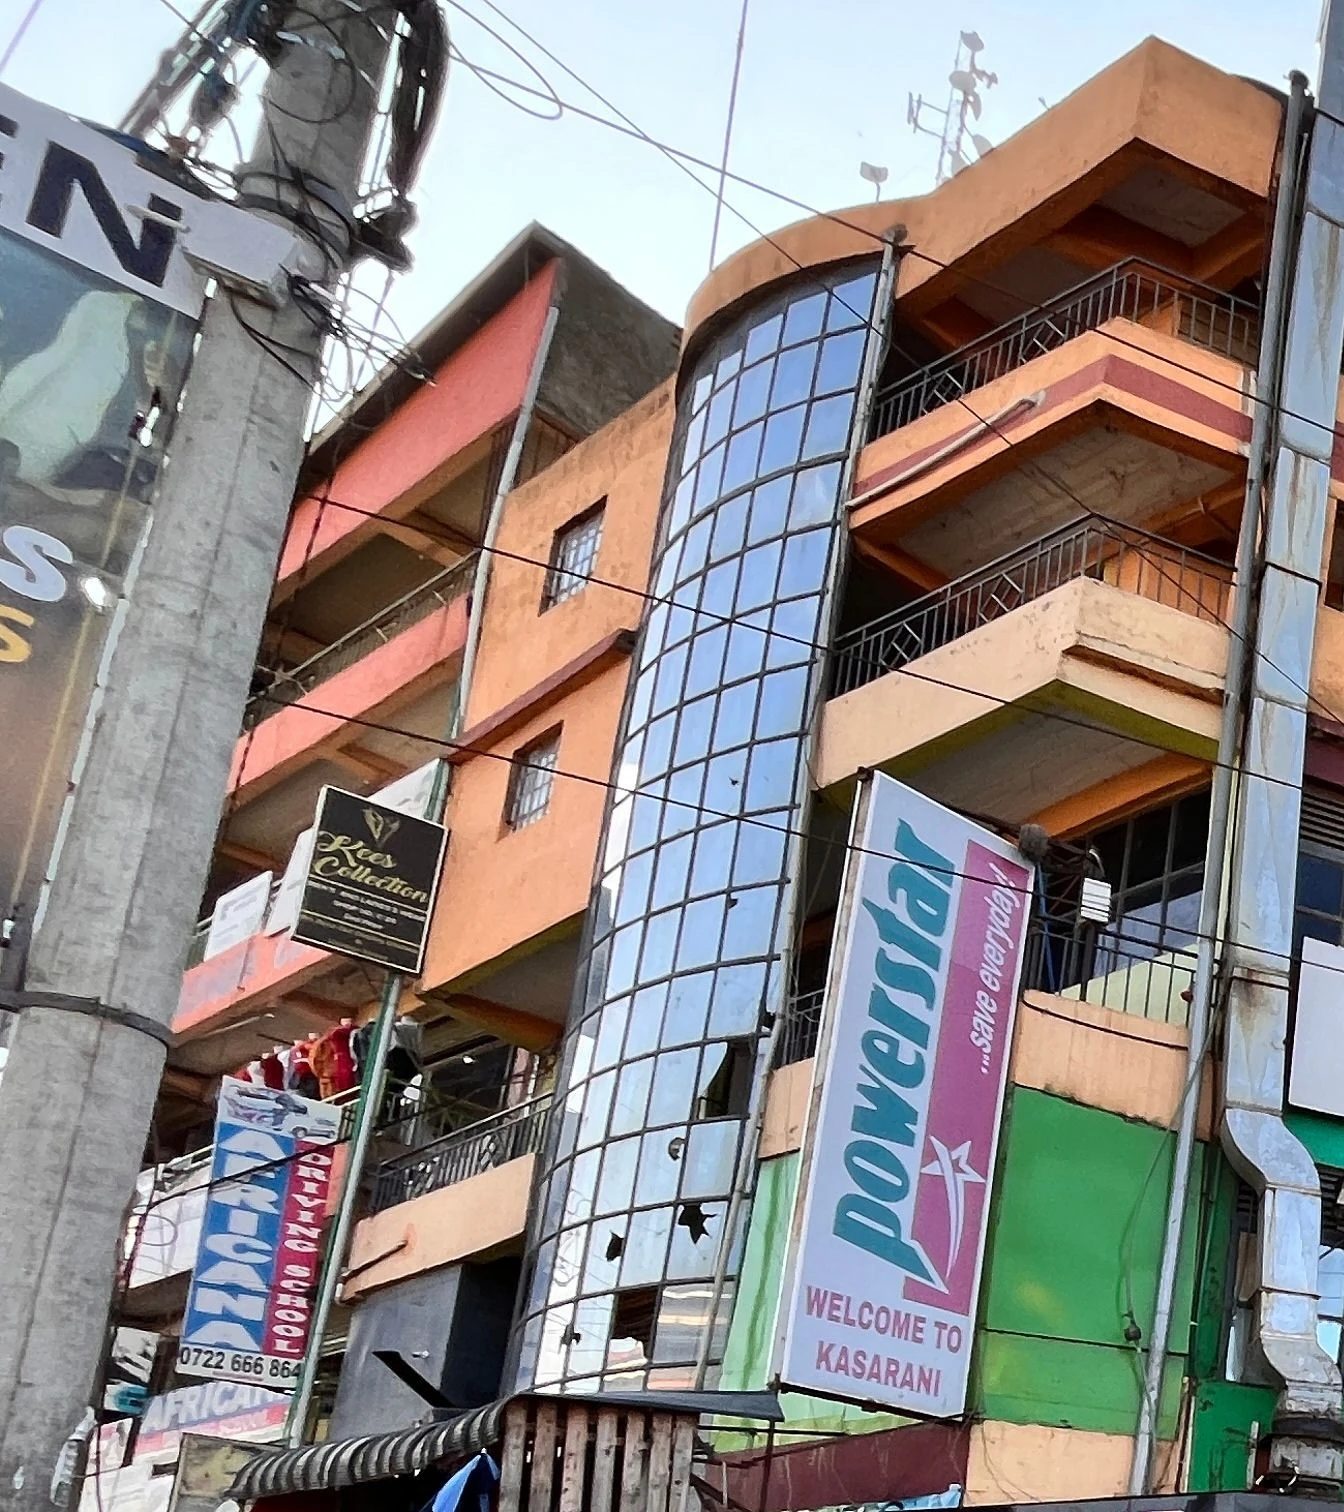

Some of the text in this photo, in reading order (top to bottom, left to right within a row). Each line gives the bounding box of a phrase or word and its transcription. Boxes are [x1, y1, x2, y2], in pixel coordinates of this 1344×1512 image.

[312, 855, 429, 903] Collection
[316, 830, 397, 868] Kees
[833, 817, 957, 1290] powerstar
[284, 1151, 332, 1253] DRIVING
[184, 1129, 287, 1353] AFRICANA
[271, 1263, 312, 1354] SCHOOL
[805, 1284, 963, 1354] WELCOME TO
[179, 1346, 225, 1370] 0722
[230, 1355, 264, 1375] 666
[815, 1339, 942, 1398] KASARANI
